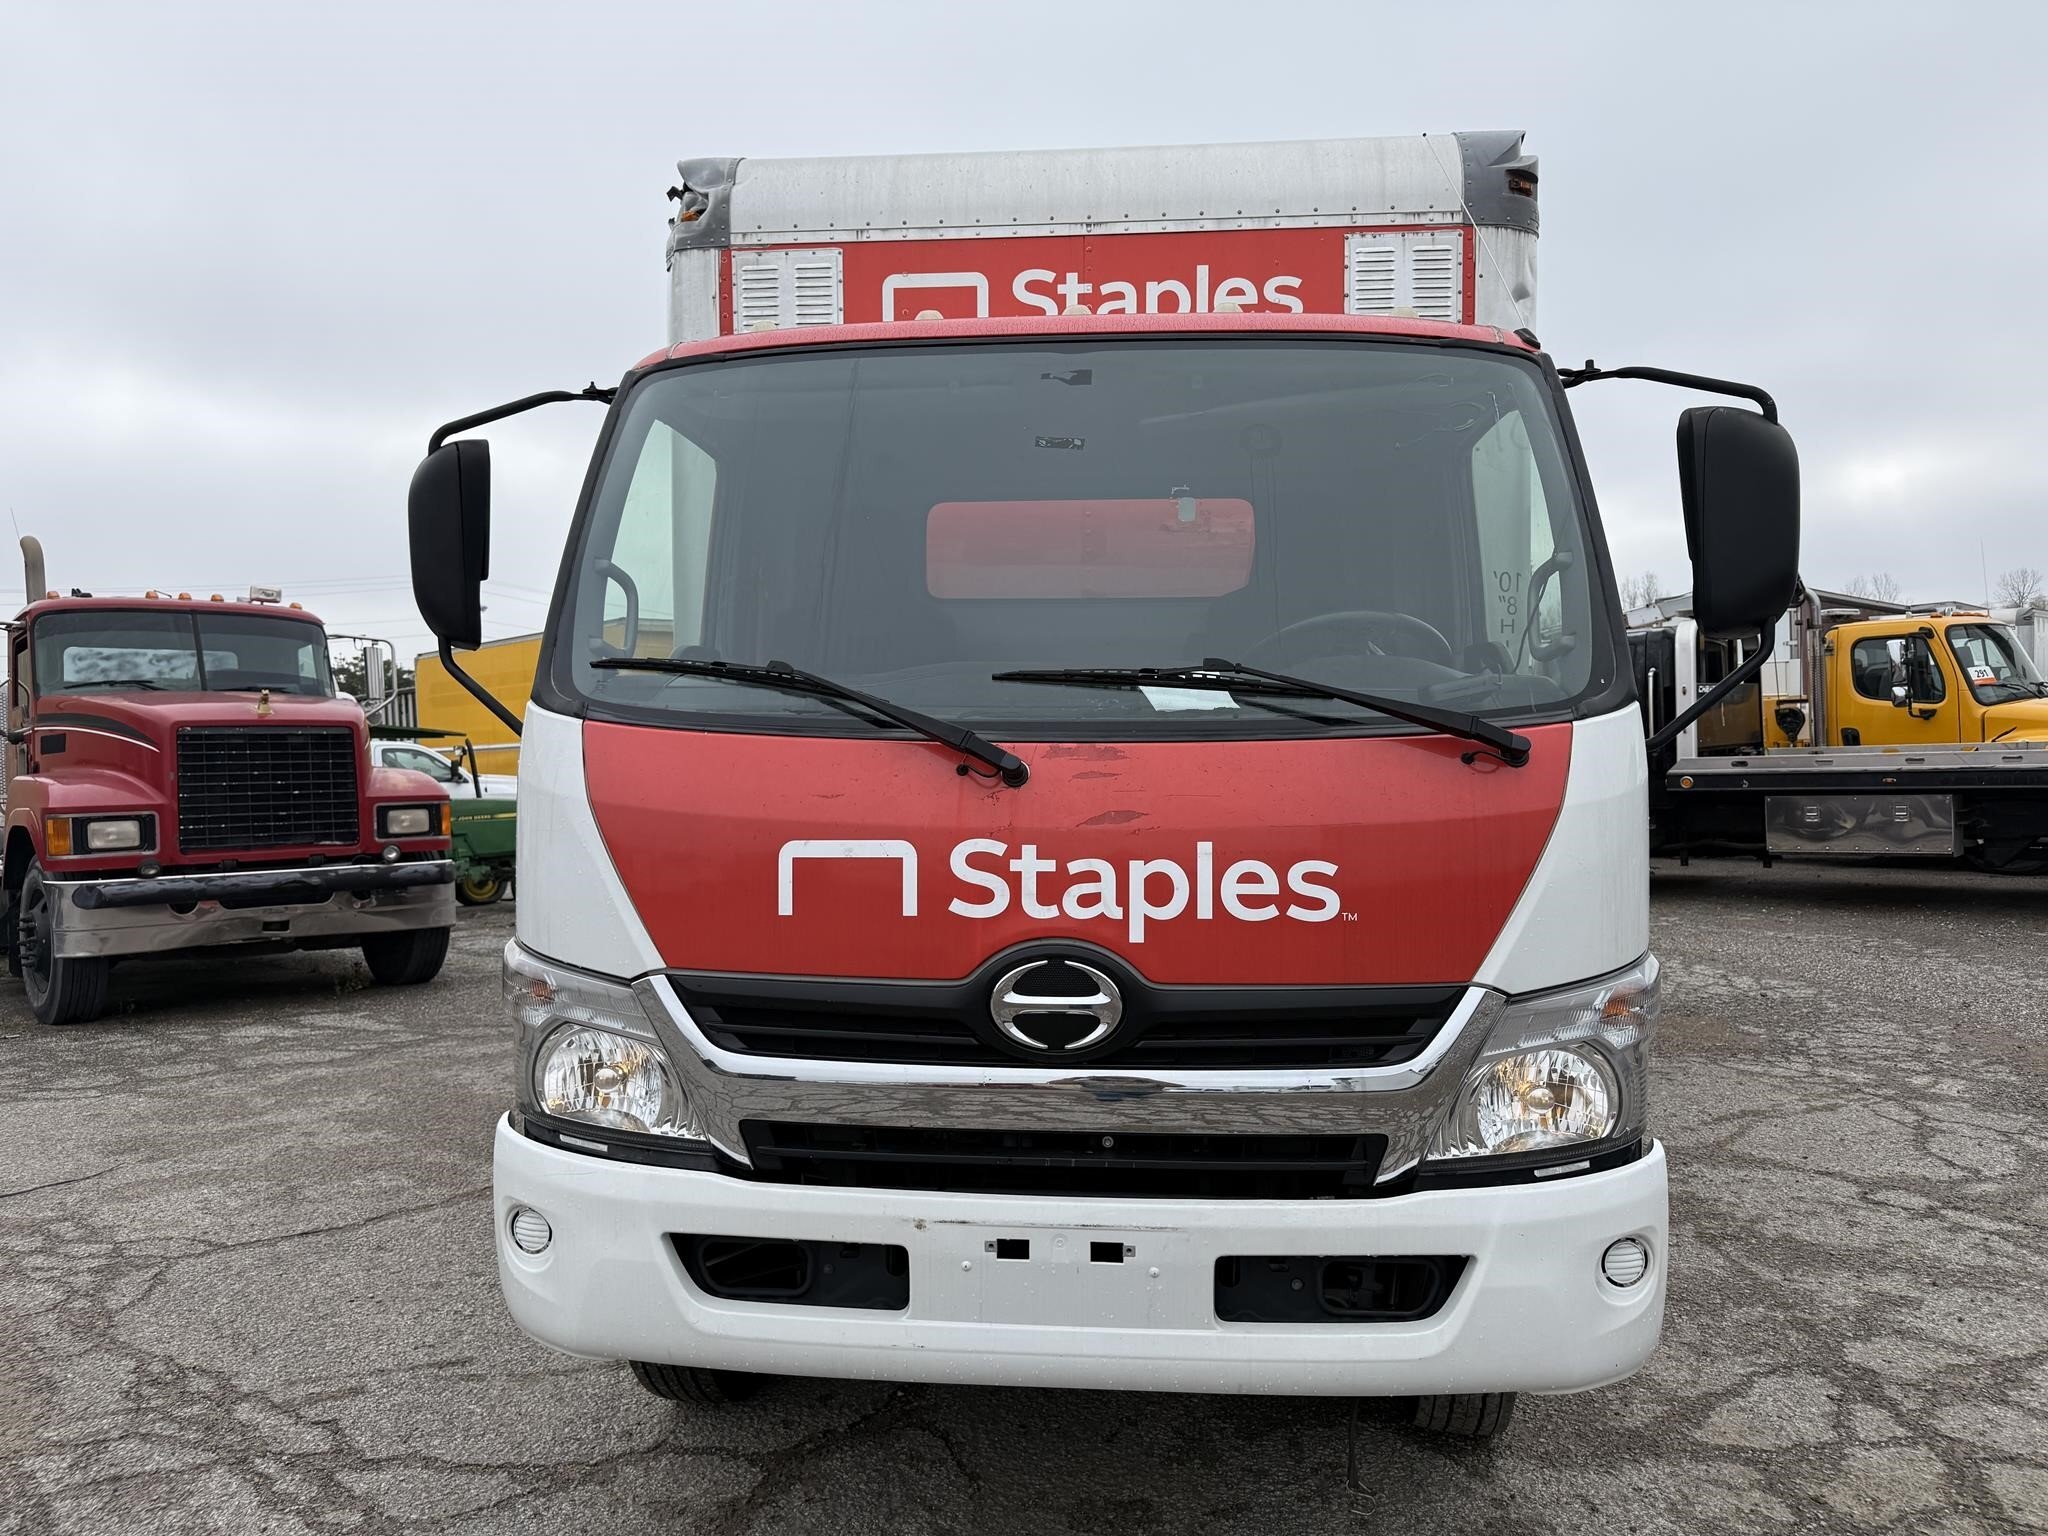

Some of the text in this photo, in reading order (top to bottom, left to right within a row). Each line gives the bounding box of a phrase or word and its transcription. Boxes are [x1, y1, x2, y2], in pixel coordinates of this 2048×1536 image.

[1974, 669, 1989, 678] 291
[948, 838, 1358, 944] Staples TM
